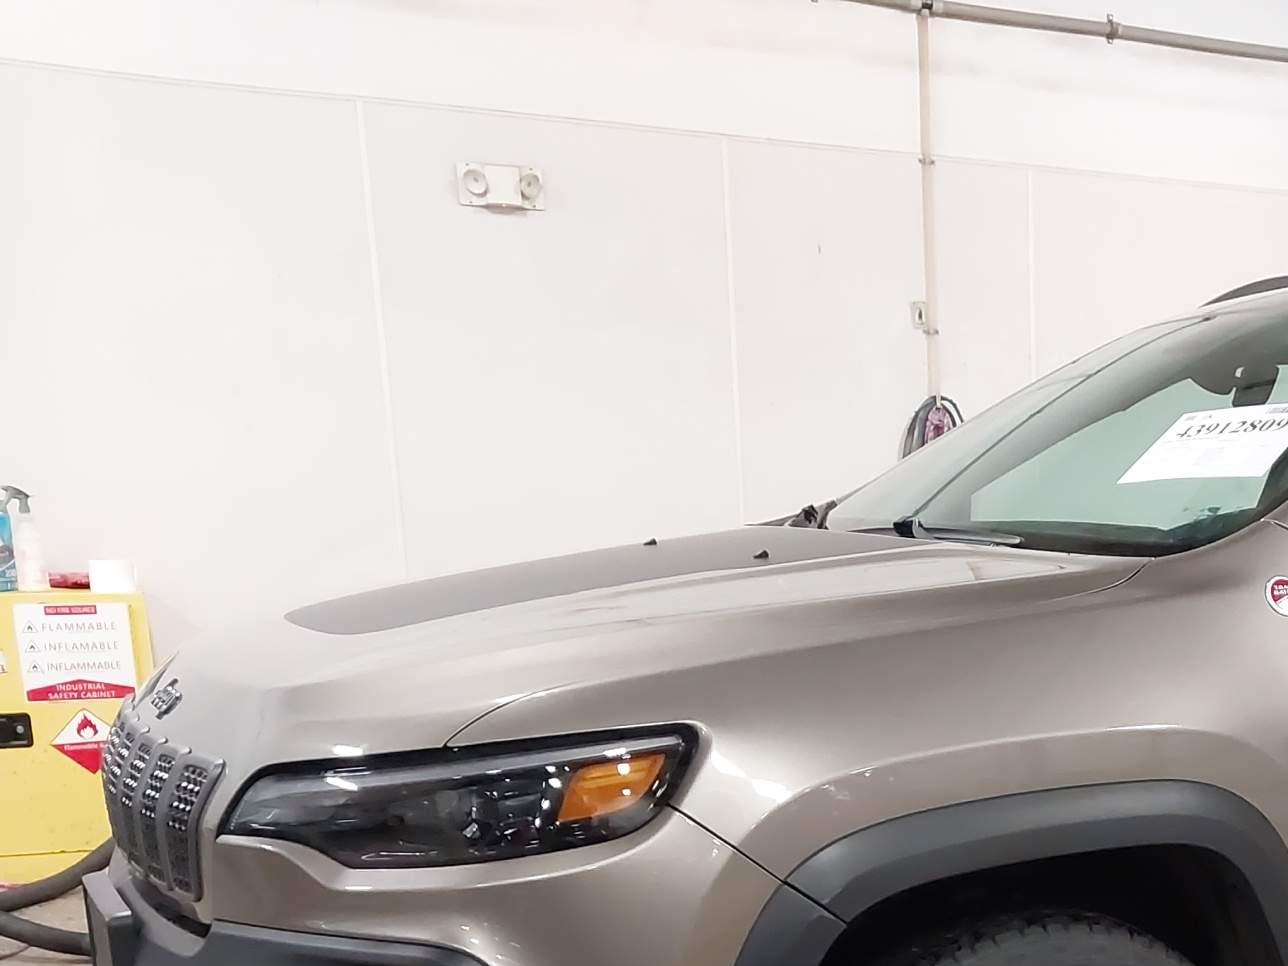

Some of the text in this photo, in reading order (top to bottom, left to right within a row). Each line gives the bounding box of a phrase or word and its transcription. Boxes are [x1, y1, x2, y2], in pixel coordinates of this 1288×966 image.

[41, 621, 117, 632] FLAMMABLE
[44, 641, 119, 652] INFLAMABLE
[47, 661, 120, 672] INFLAMMABLE
[56, 682, 106, 691] INDUSTRIAL
[48, 690, 116, 700] SAFETY CABINET
